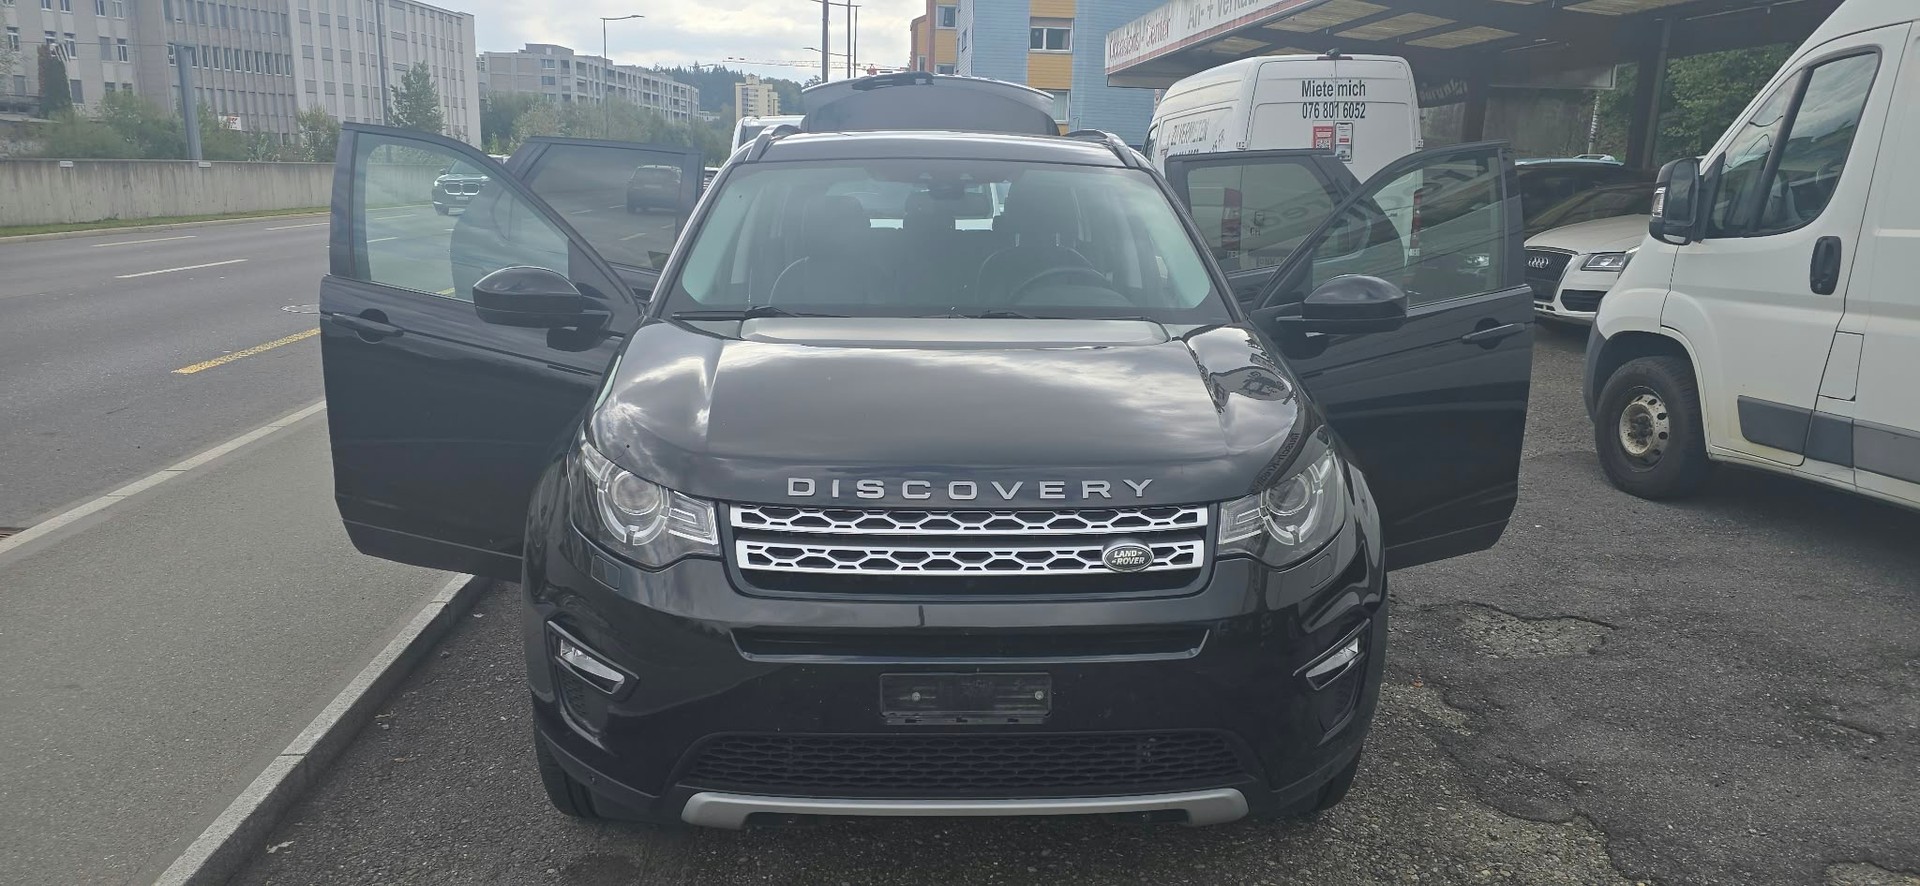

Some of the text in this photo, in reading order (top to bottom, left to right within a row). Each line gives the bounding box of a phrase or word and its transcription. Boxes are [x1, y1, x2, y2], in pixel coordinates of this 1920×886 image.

[1301, 79, 1366, 97] Miete mich
[1302, 101, 1366, 119] 076 801 6052
[787, 477, 1153, 500] DISCOVERY
[1113, 550, 1137, 558] LAND
[1116, 556, 1145, 566] ROVER
